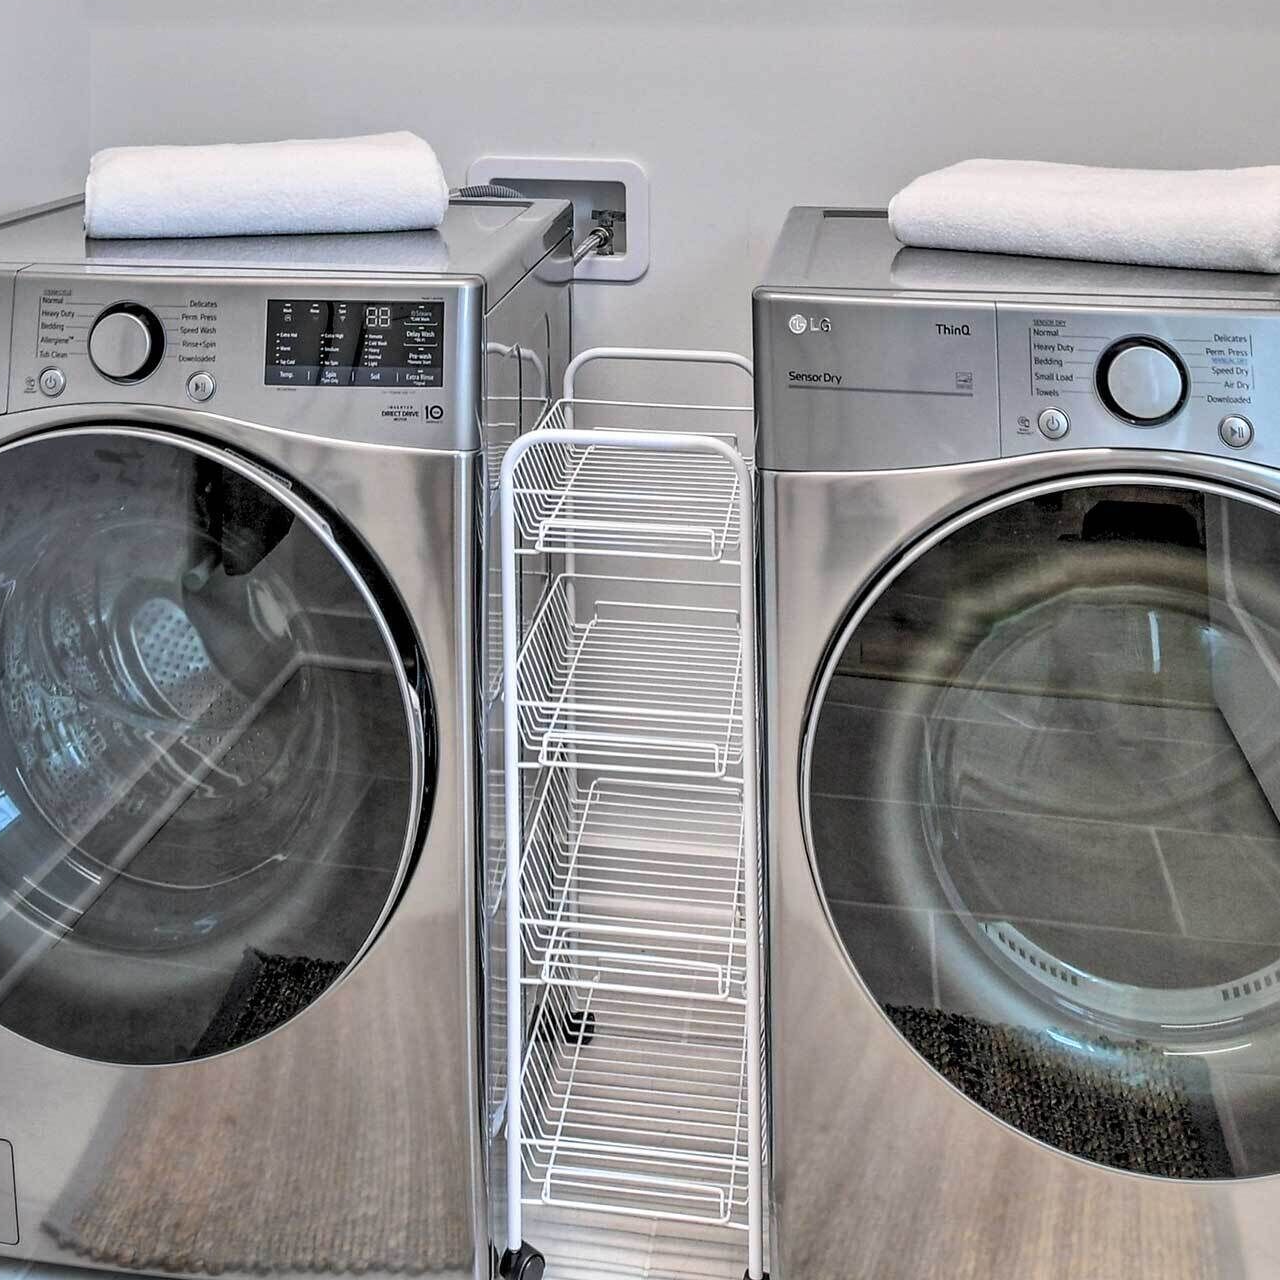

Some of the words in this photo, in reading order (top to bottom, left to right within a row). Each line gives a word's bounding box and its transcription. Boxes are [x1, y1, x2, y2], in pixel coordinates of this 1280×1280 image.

[810, 317, 832, 333] LG
[935, 323, 971, 336] ThinQ
[1033, 328, 1060, 337] Normal
[1213, 333, 1248, 343] Delicates
[1033, 343, 1055, 353] Heavy
[1057, 343, 1074, 353] Duty
[1227, 348, 1249, 357] Press
[1034, 357, 1063, 368] Bedding
[1211, 366, 1234, 376] Speed
[1235, 366, 1249, 376] Dry
[823, 372, 842, 384] Dry
[1034, 372, 1055, 381] Small
[1056, 373, 1074, 382] Load
[1223, 380, 1235, 389] Air
[1236, 380, 1250, 390] Dry
[1036, 387, 1060, 397] Towels
[1206, 394, 1252, 404] Downloaded
[425, 405, 444, 420] 10
